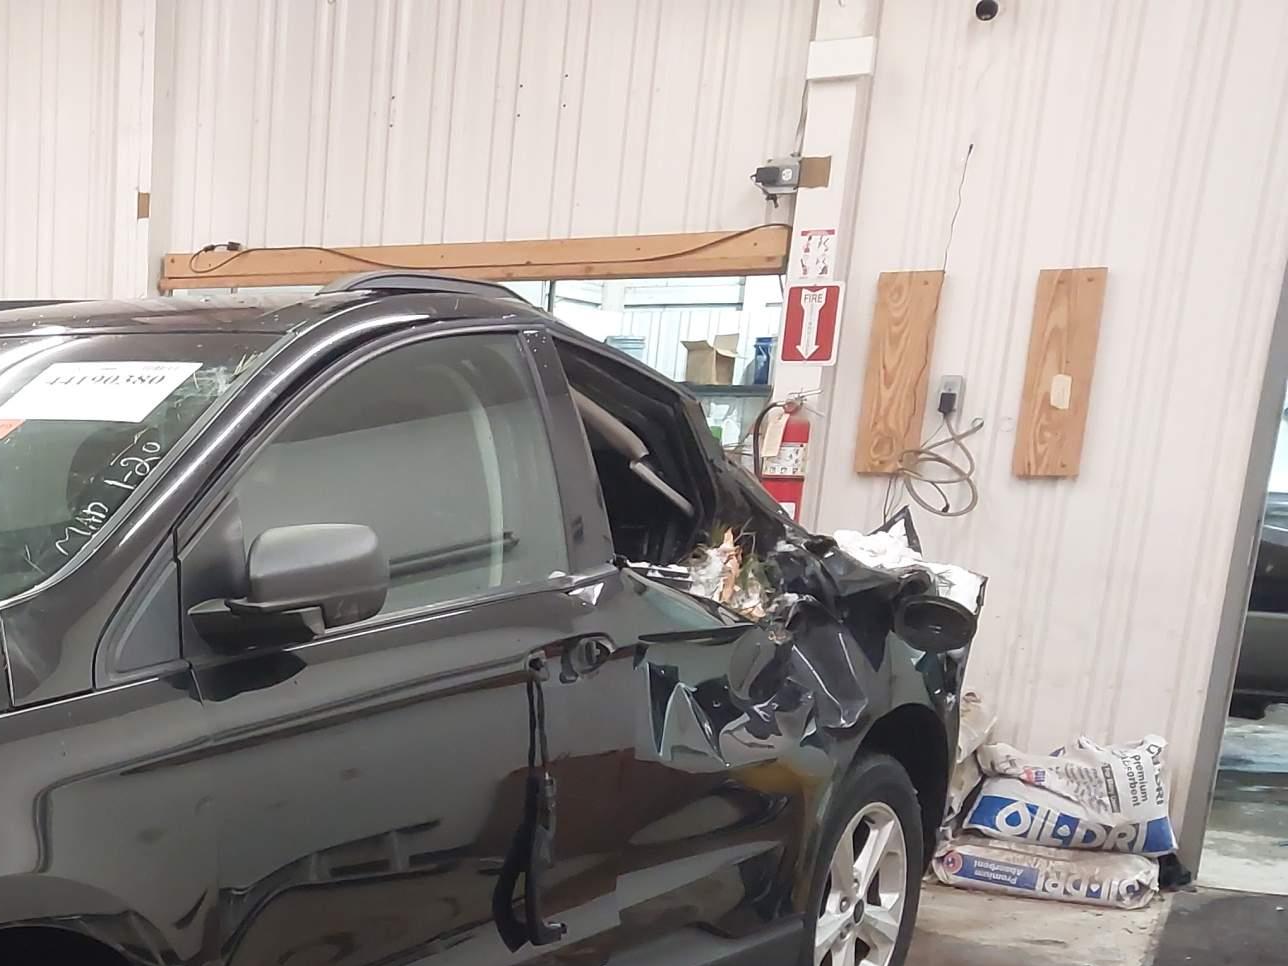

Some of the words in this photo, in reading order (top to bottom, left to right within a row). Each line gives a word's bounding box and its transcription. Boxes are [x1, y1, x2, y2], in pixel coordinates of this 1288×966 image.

[804, 293, 823, 304] FIRE
[1130, 755, 1149, 802] Premium
[974, 869, 1017, 884] Premium
